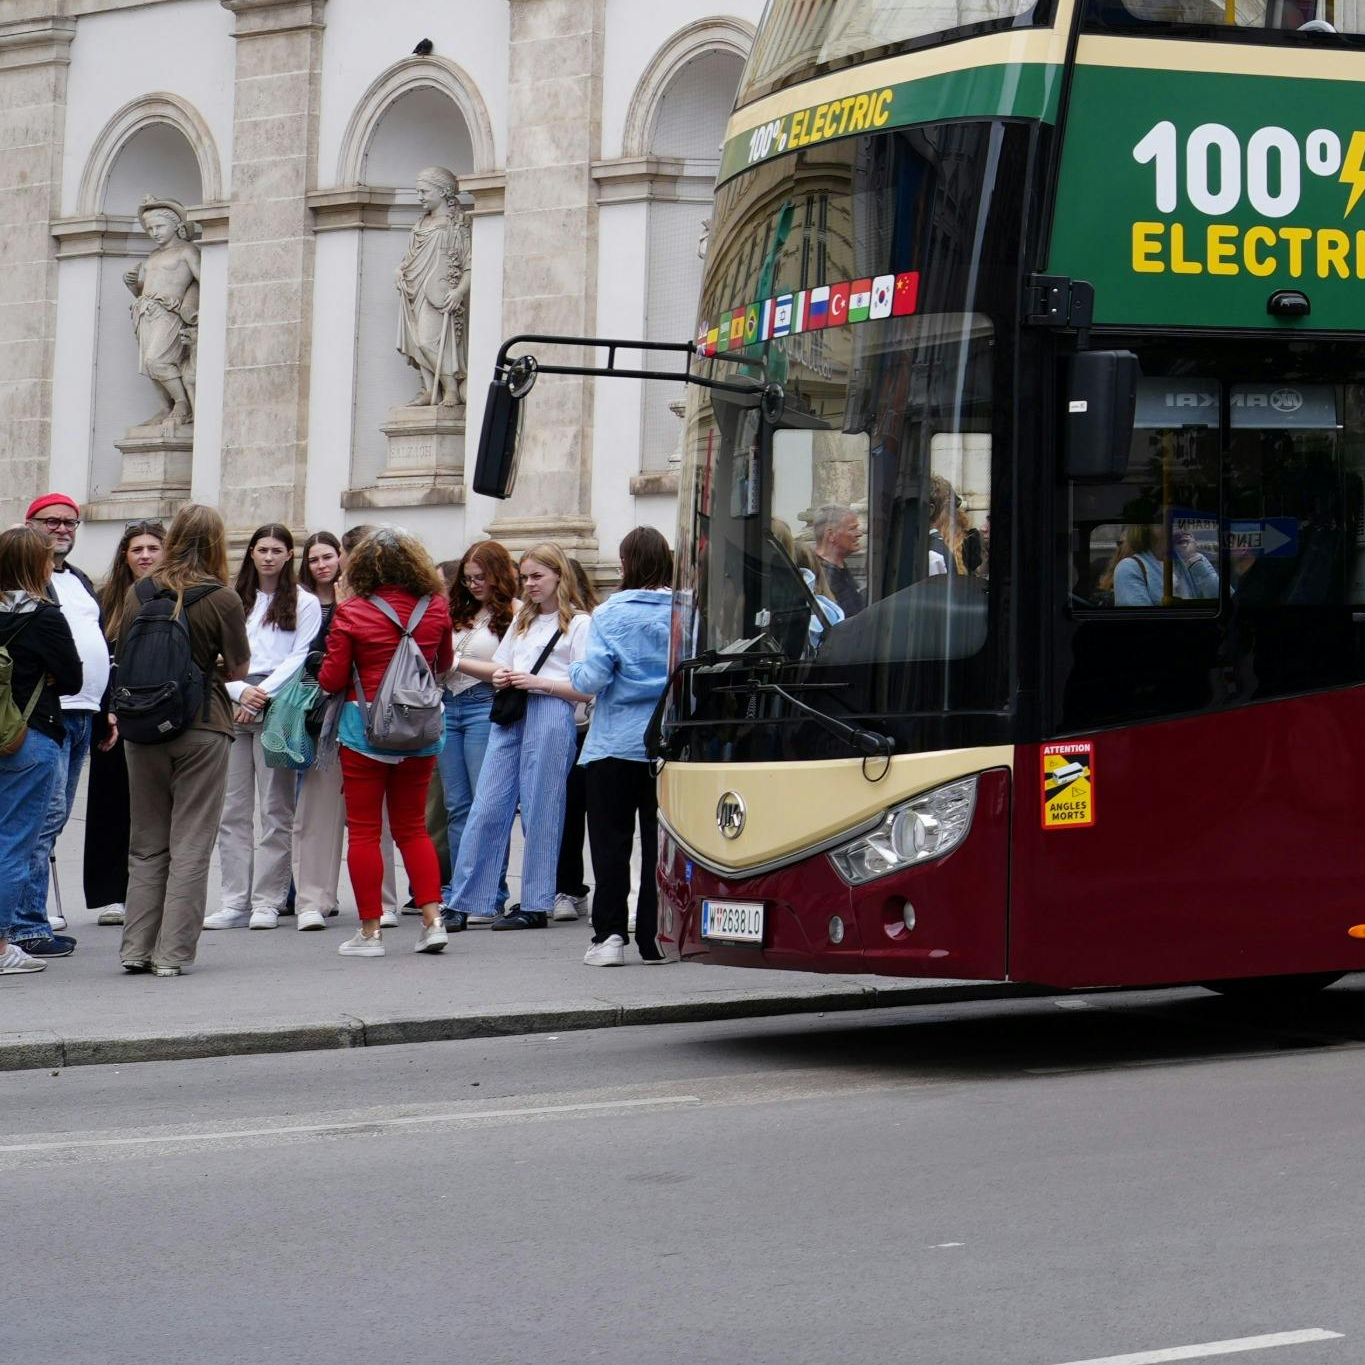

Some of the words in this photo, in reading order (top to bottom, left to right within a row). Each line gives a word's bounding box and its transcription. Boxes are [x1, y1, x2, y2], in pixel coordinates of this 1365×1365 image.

[748, 118, 787, 164] 100%
[787, 88, 893, 150] ELECTRIC
[1044, 743, 1091, 754] ATTENTION
[1049, 801, 1087, 812] ANGLES
[1052, 811, 1086, 821] MORTS
[709, 906, 716, 932] W
